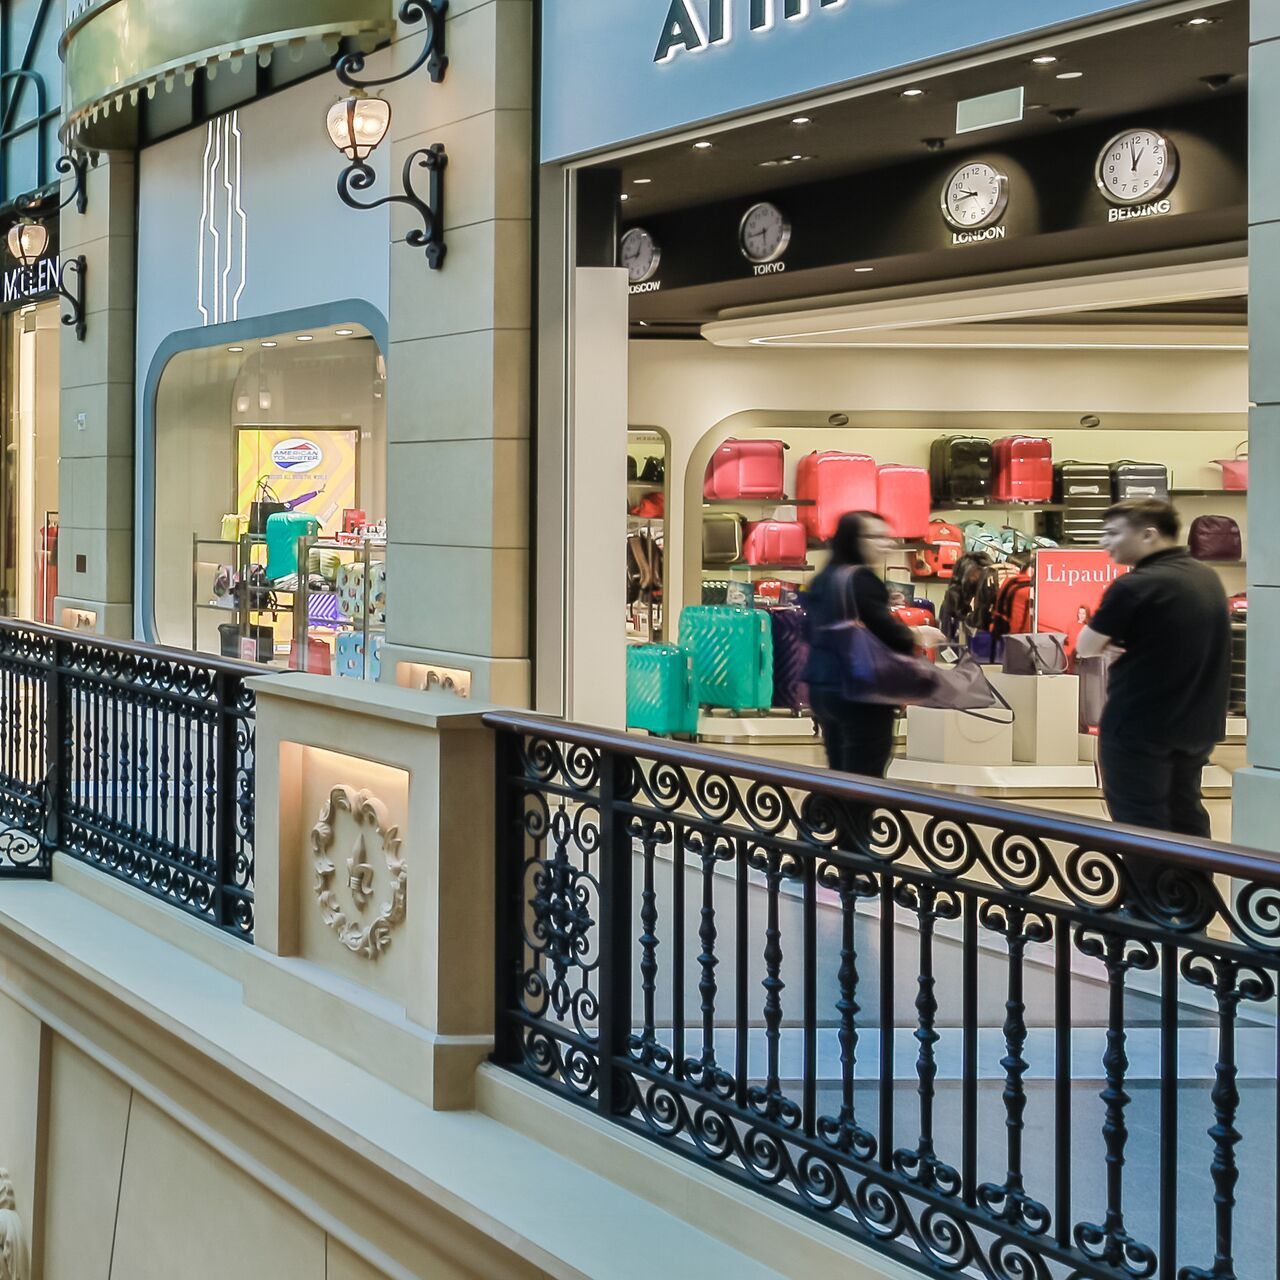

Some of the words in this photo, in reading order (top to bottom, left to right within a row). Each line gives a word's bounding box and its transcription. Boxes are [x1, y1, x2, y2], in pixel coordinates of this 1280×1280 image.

[1108, 200, 1170, 222] BEIJING
[952, 226, 1006, 245] LONDON
[753, 261, 785, 276] TOKYO
[629, 280, 661, 294] OSCOW
